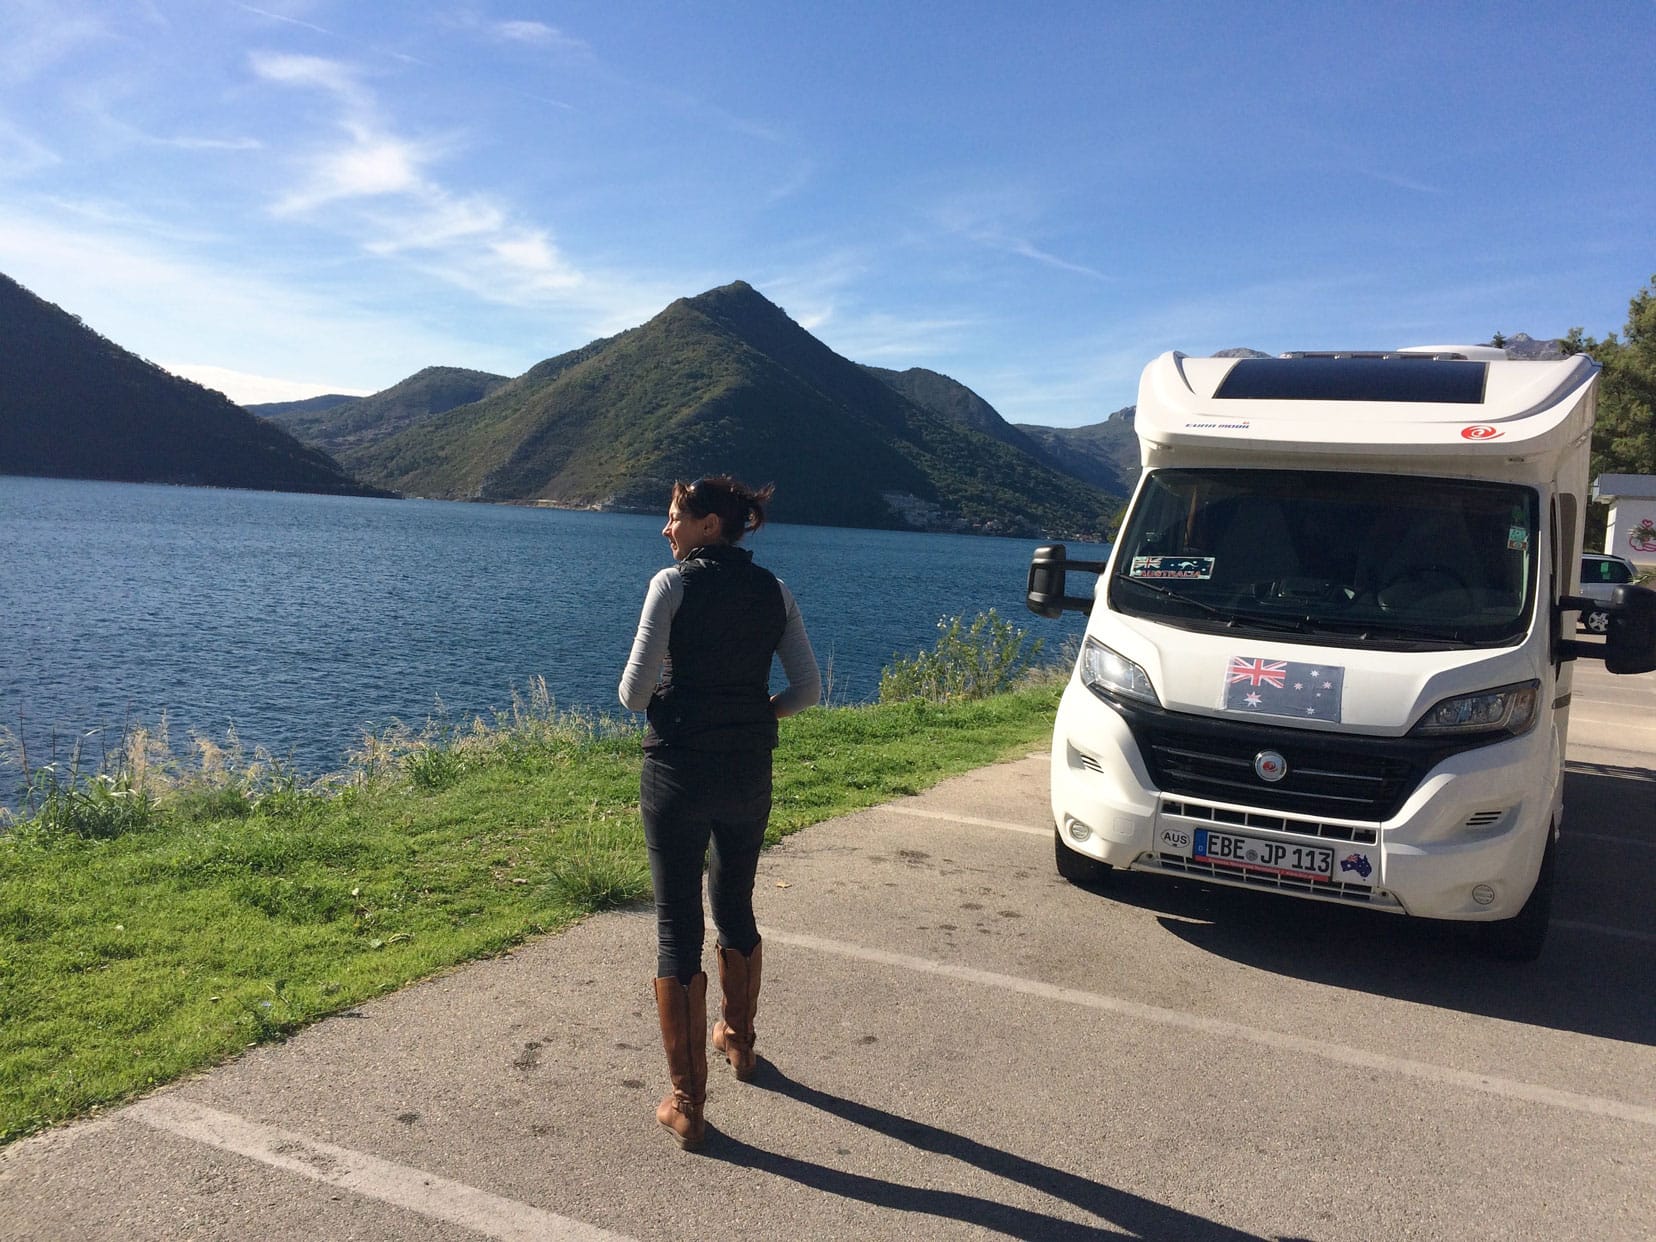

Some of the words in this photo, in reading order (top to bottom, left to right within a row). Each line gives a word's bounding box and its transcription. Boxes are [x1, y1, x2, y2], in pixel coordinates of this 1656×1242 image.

[1164, 831, 1188, 845] AUS
[1208, 834, 1246, 860] EBE
[1260, 843, 1287, 866] JP
[1291, 848, 1331, 873] 113
